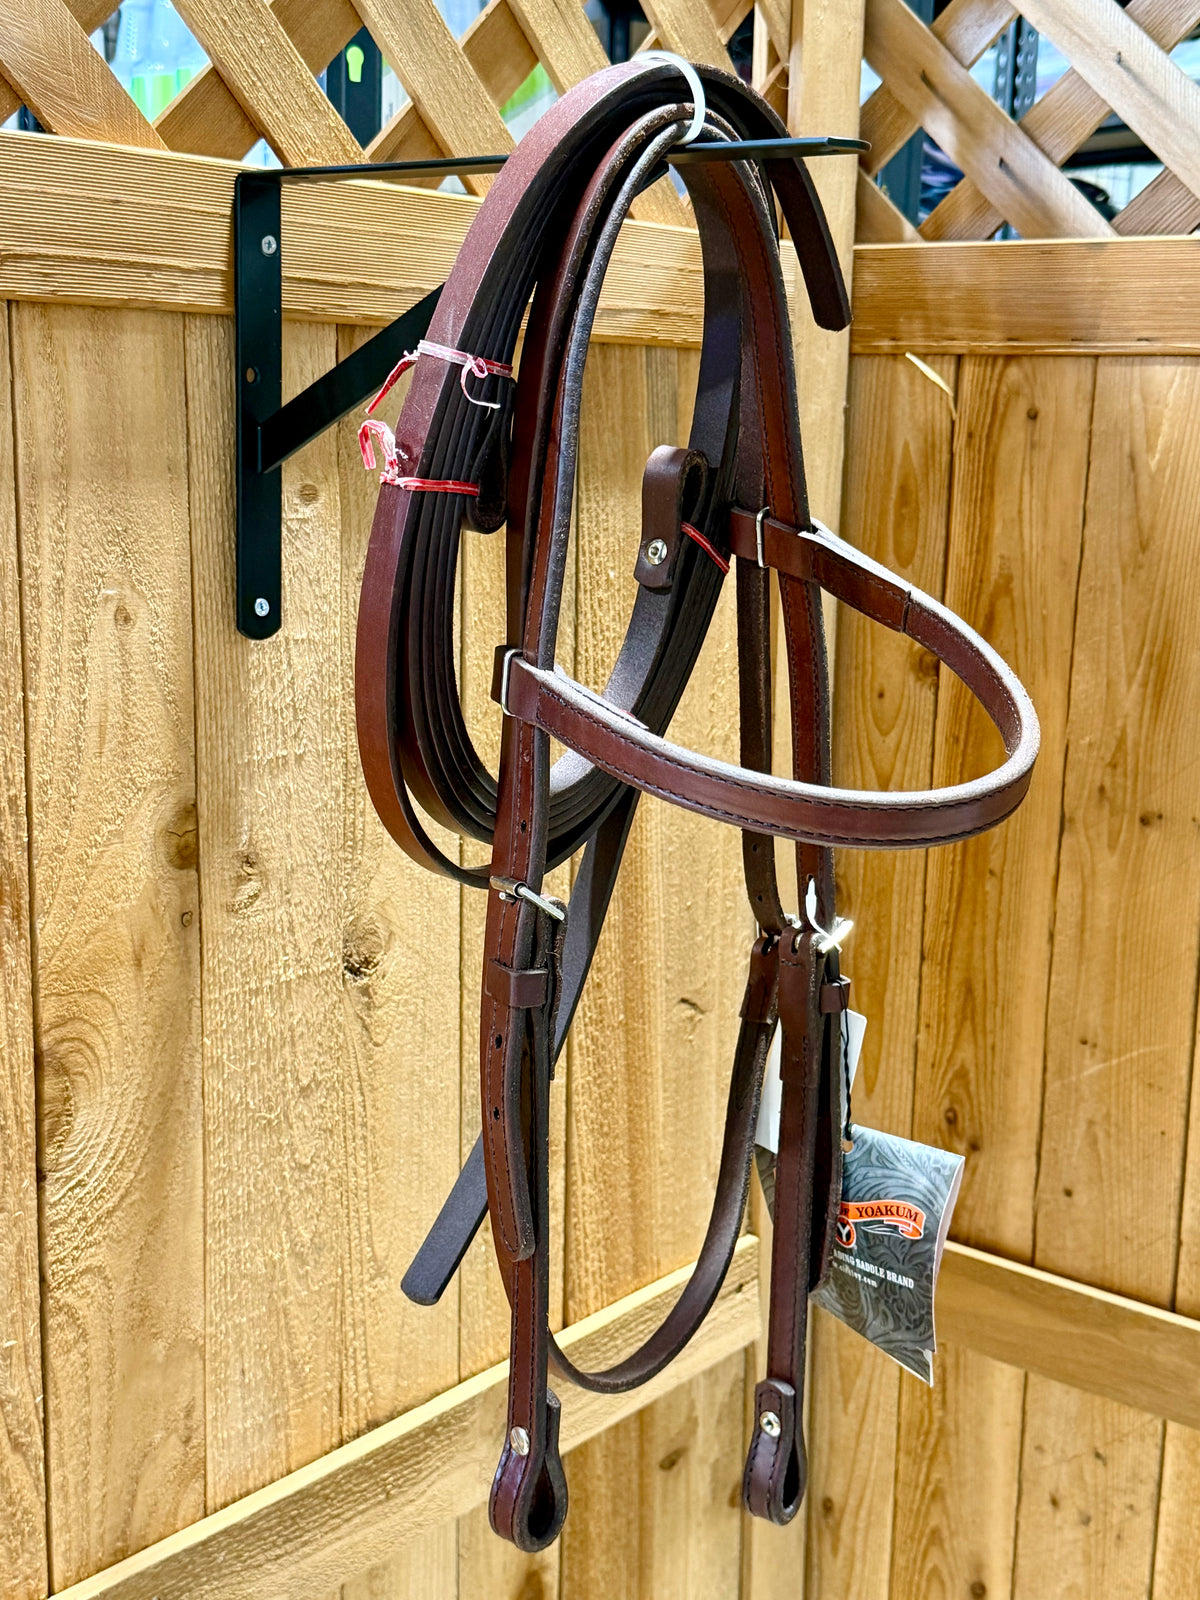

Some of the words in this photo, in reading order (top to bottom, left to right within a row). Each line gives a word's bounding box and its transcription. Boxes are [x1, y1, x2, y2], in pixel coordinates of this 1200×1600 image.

[856, 1205, 920, 1223] YOAKUM
[855, 1258, 885, 1279] SADDLE
[886, 1270, 914, 1289] BRAND
